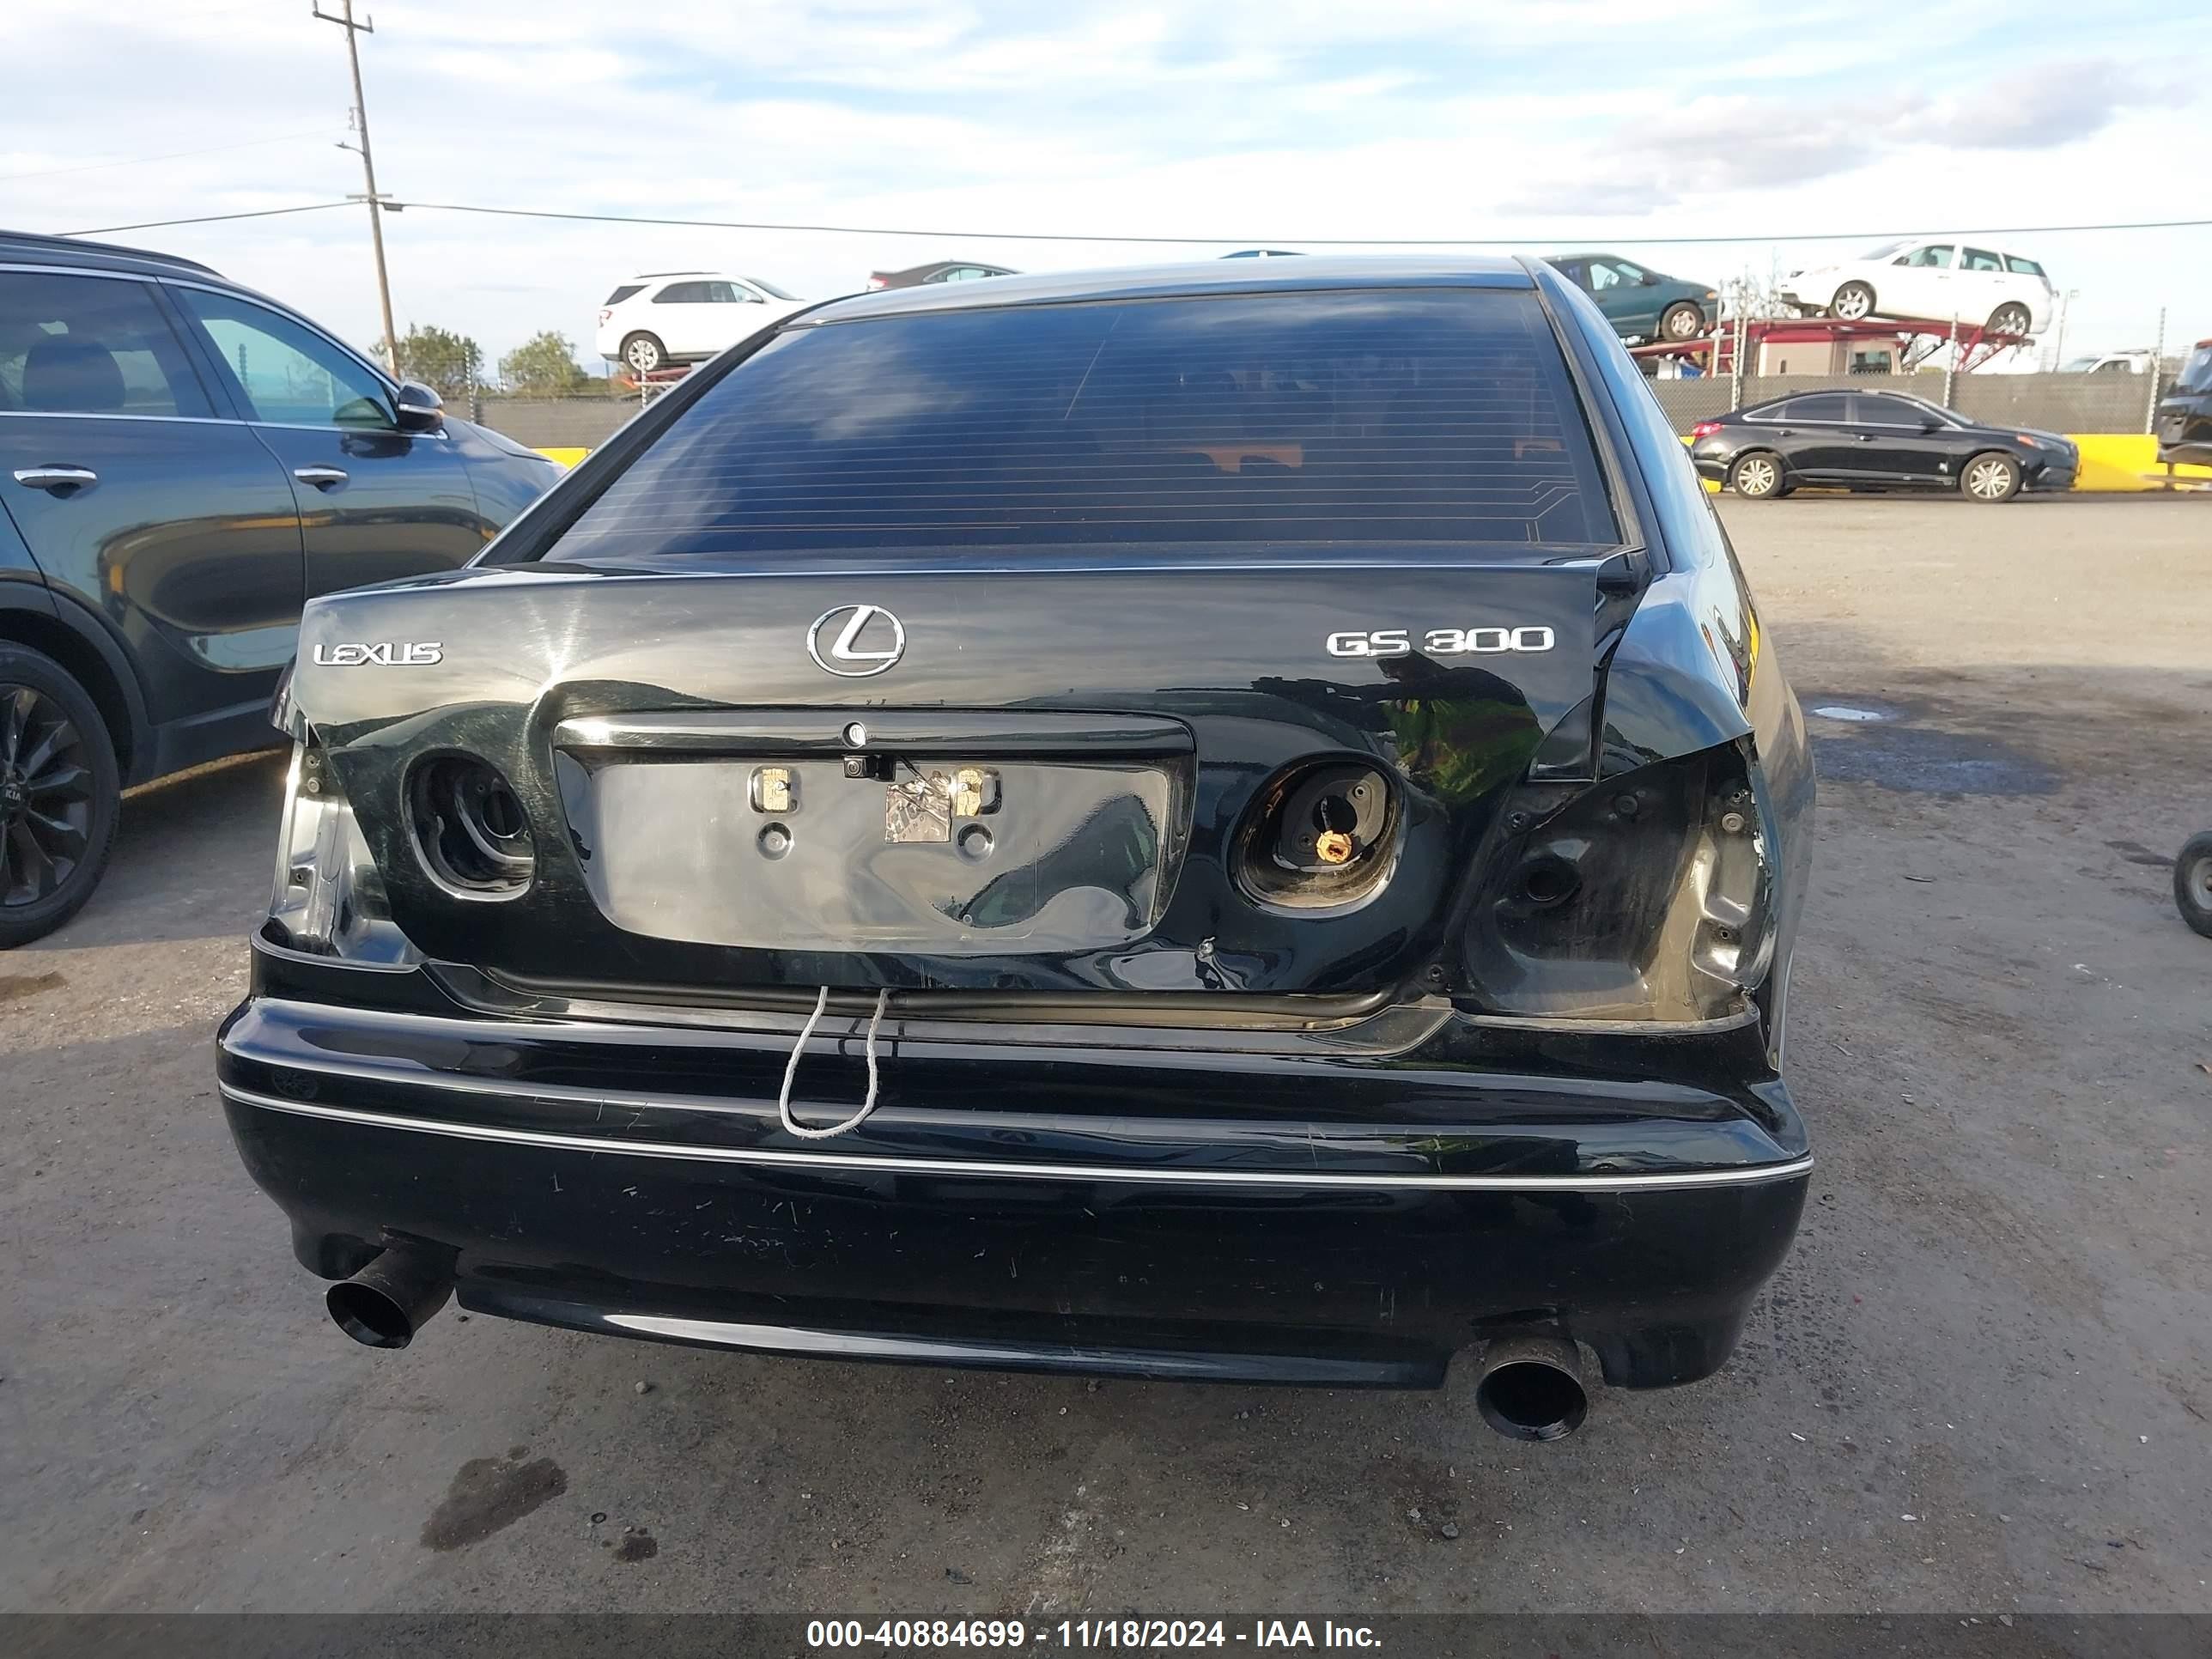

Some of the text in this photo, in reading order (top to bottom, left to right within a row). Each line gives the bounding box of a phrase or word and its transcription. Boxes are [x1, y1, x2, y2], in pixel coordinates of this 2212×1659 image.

[1327, 626, 1555, 657] GS 300
[313, 642, 442, 665] LEXUS
[5, 789, 21, 801] KIA
